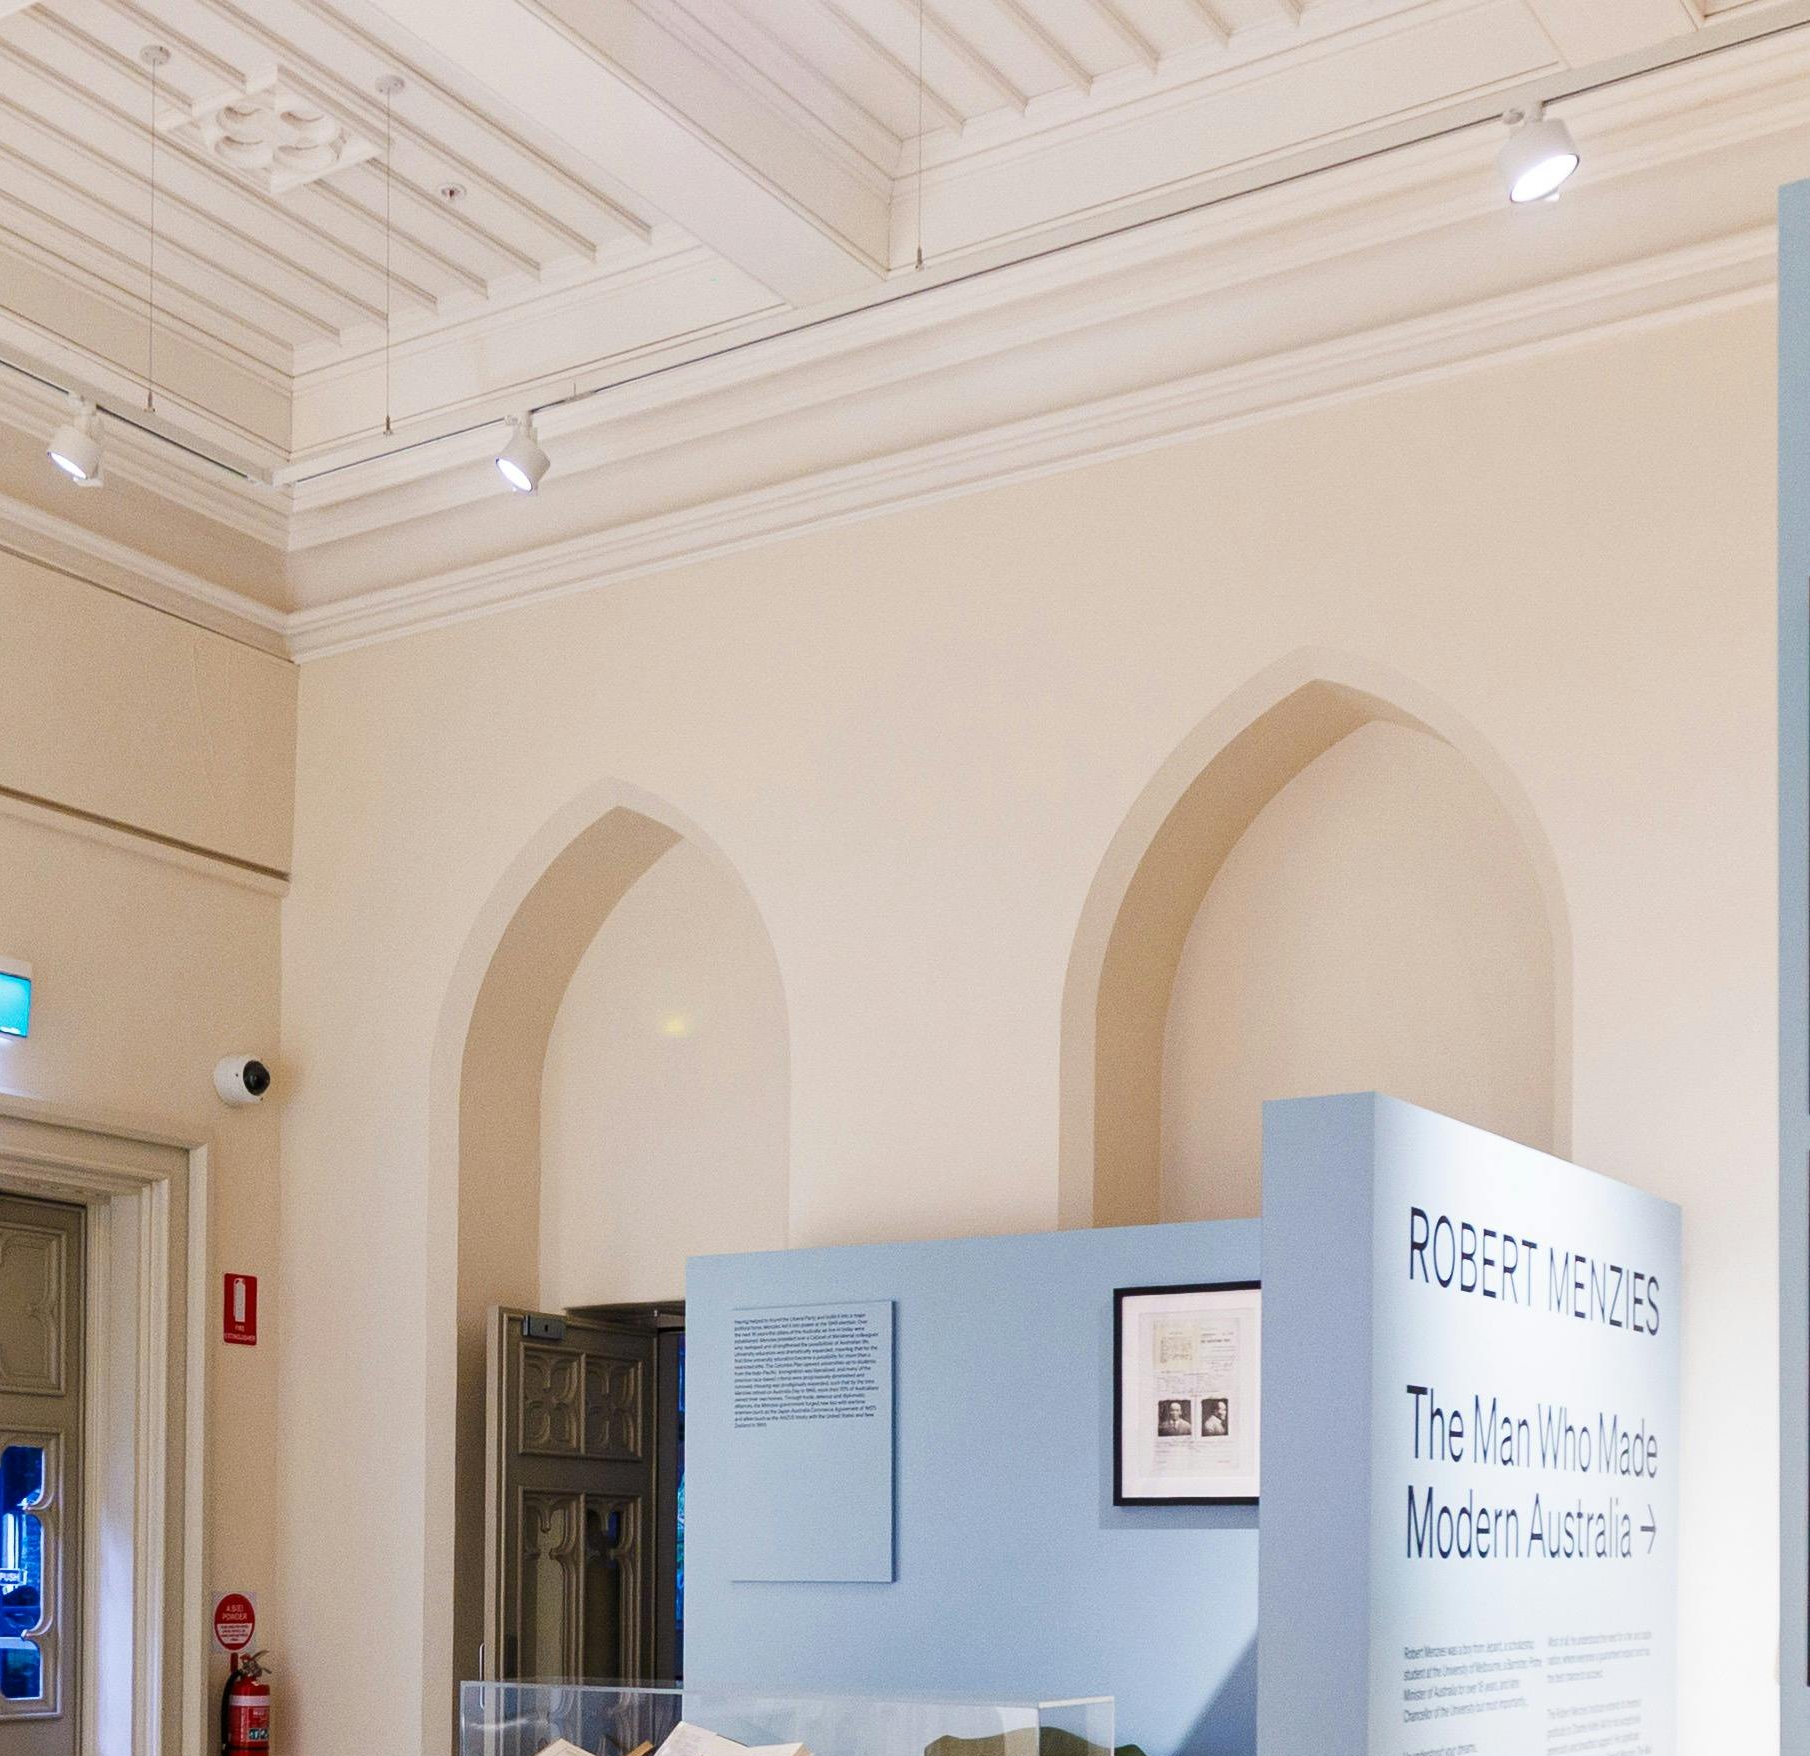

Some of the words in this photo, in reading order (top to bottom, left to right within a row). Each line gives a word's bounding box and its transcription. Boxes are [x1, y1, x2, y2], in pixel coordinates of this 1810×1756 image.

[1408, 1206, 1538, 1308] ROBERT
[1547, 1245, 1661, 1337] MENZIES
[1406, 1384, 1465, 1463] The
[1474, 1394, 1531, 1469] Man
[1537, 1403, 1593, 1474] Who
[1598, 1412, 1659, 1479] Made
[1406, 1485, 1520, 1560] Modern
[1529, 1492, 1633, 1560] Australia
